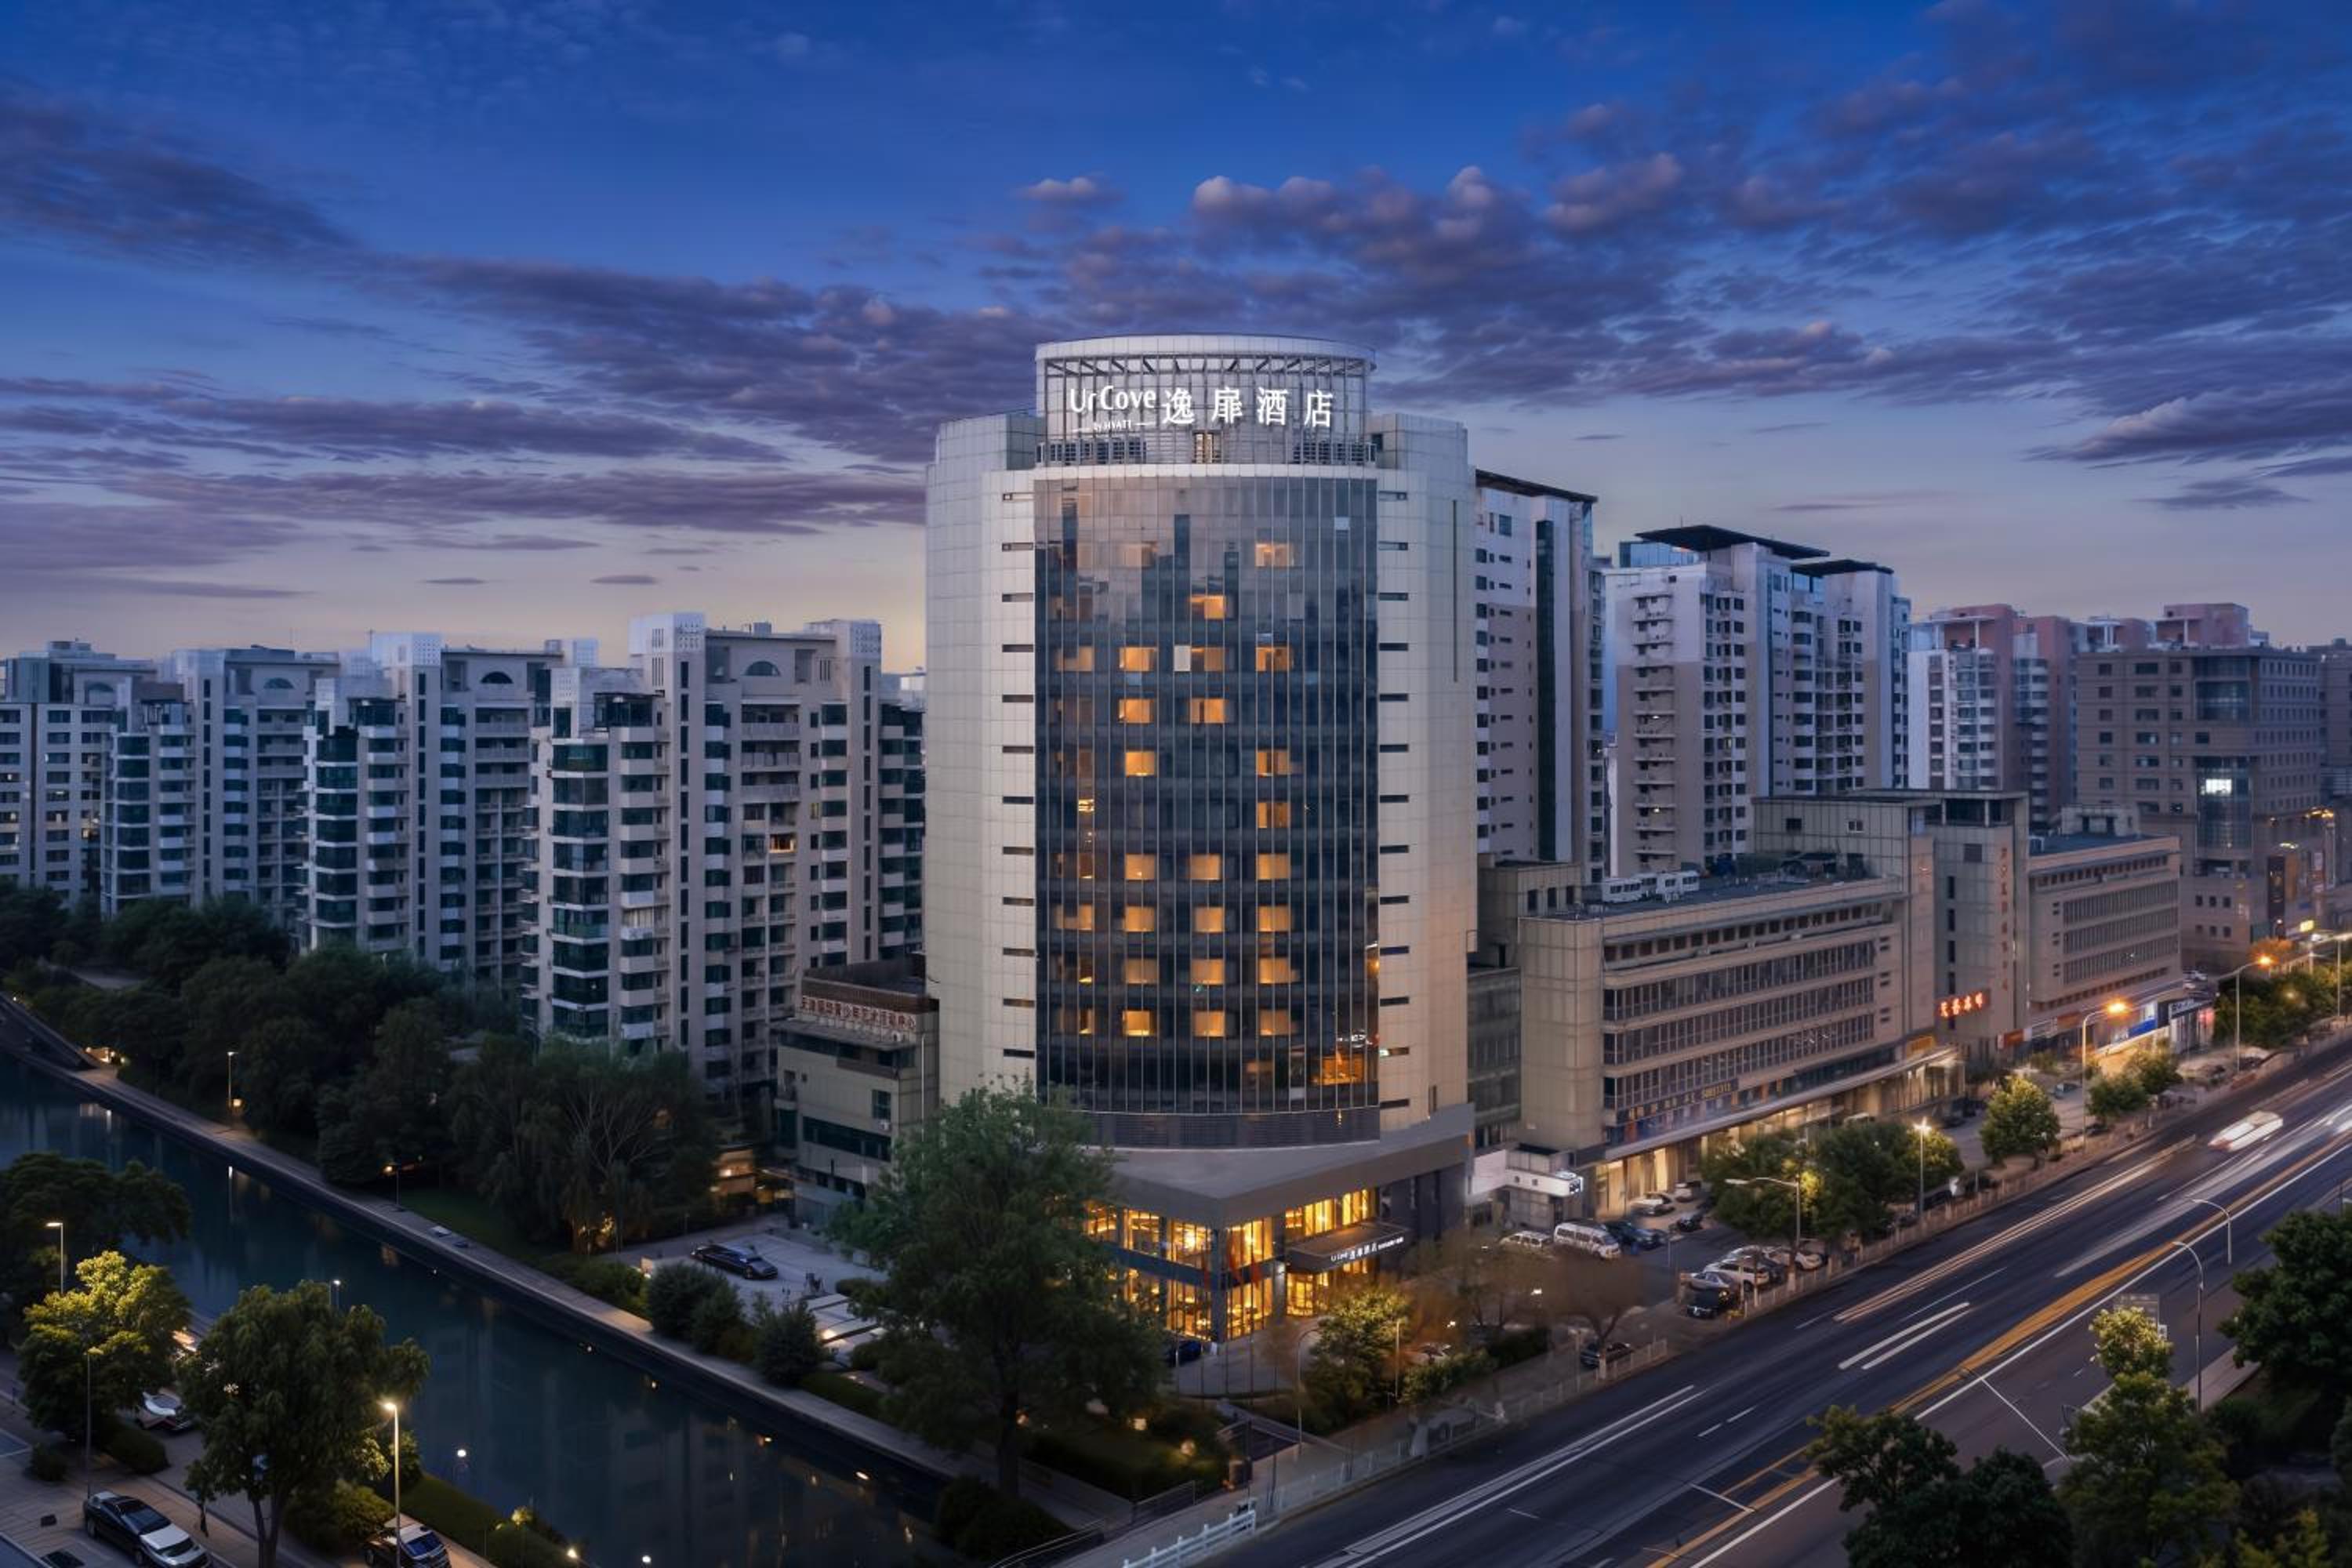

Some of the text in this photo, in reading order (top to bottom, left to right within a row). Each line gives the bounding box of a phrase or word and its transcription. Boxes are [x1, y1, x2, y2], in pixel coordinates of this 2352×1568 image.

[1070, 385, 1156, 413] UrCove
[1161, 387, 1333, 427] 逸扉酒店
